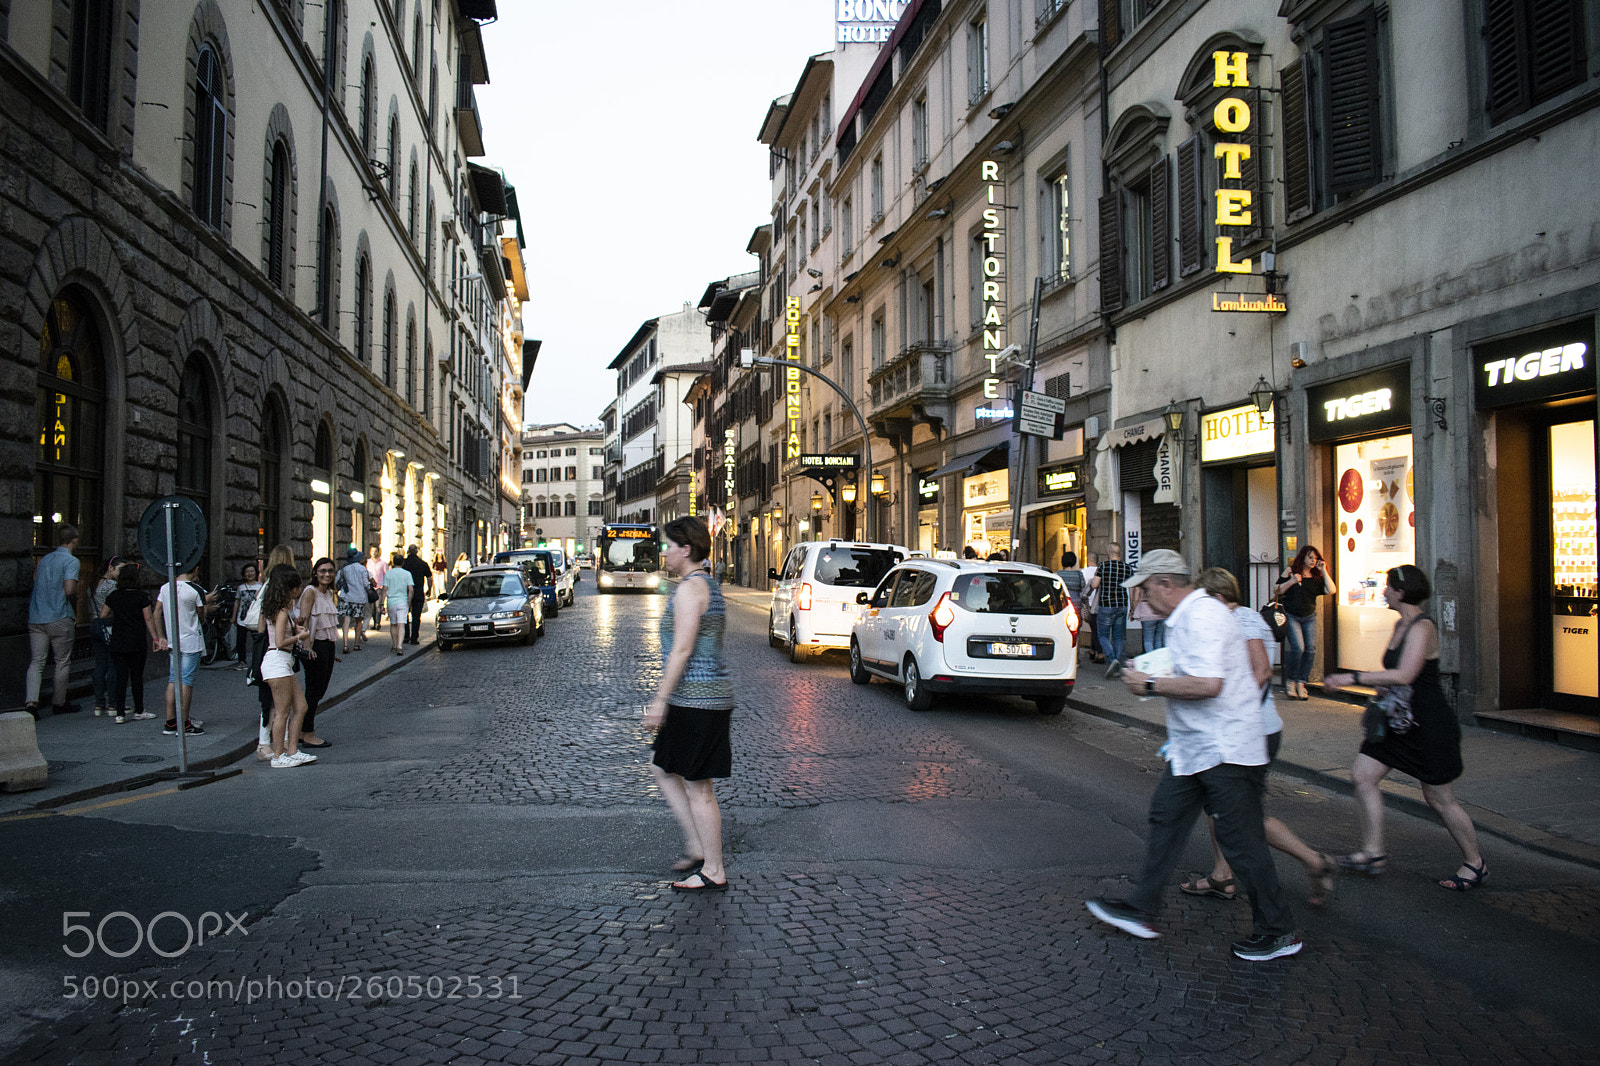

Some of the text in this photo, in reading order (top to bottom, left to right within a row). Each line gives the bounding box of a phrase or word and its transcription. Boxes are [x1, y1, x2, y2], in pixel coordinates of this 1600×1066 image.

[1213, 50, 1252, 273] HOTEL
[982, 160, 1001, 399] RISTORANTE
[1213, 292, 1287, 312] Lombardia
[786, 296, 801, 360] HOTEL
[1484, 342, 1588, 388] TIGER
[976, 406, 1014, 419] pizzeria
[1324, 388, 1393, 423] TIGER
[1123, 425, 1145, 439] CHANGE
[1206, 409, 1269, 441] HOTEL
[724, 429, 736, 497] SABATINI
[802, 456, 824, 466] HOTEL
[1160, 442, 1172, 491] CHANGE
[608, 530, 617, 538] 22
[1128, 531, 1139, 573] ANGE
[1563, 626, 1589, 635] TIGER
